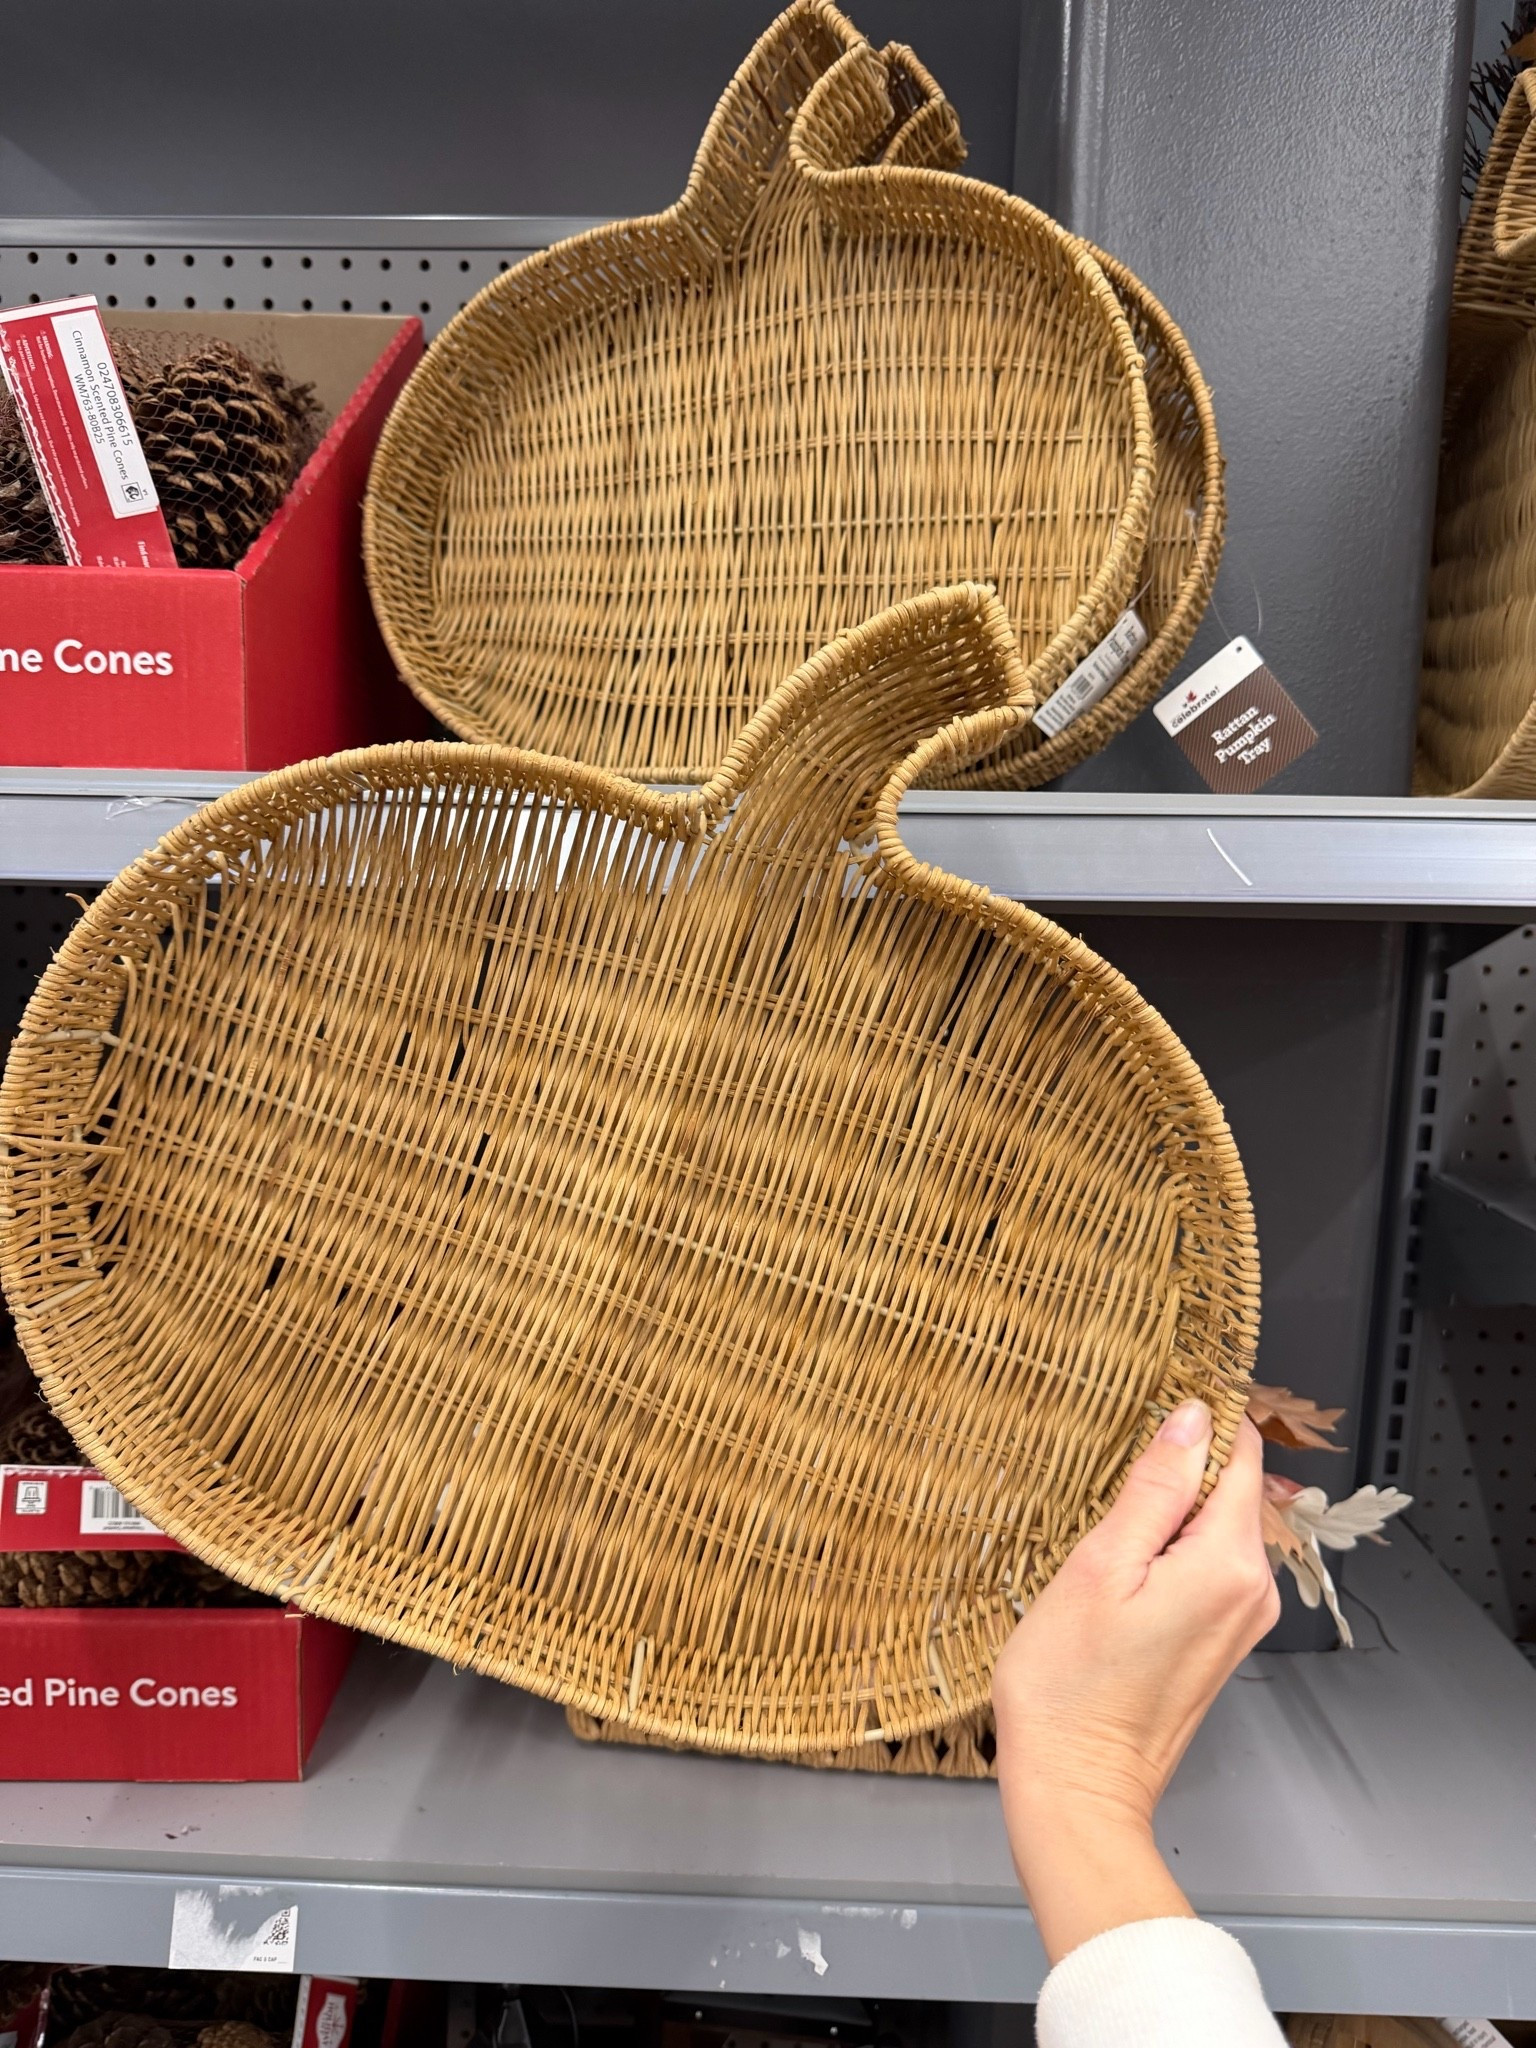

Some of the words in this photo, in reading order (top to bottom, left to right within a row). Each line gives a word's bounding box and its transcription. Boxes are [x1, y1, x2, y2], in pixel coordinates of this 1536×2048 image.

[20, 339, 37, 370] ADVERTENCIA:
[71, 330, 97, 381] Cinnamon
[89, 383, 111, 424] Scented
[103, 426, 119, 447] Pine
[111, 449, 130, 479] Cones
[95, 361, 133, 445] 024708306615
[0, 648, 44, 673] ne
[54, 638, 174, 676] Cones
[1211, 706, 1260, 745] Rattan
[1214, 713, 1278, 764] Pumpkin
[1237, 737, 1271, 765] Tray
[45, 1678, 120, 1707] Pine
[129, 1677, 239, 1707] Cones
